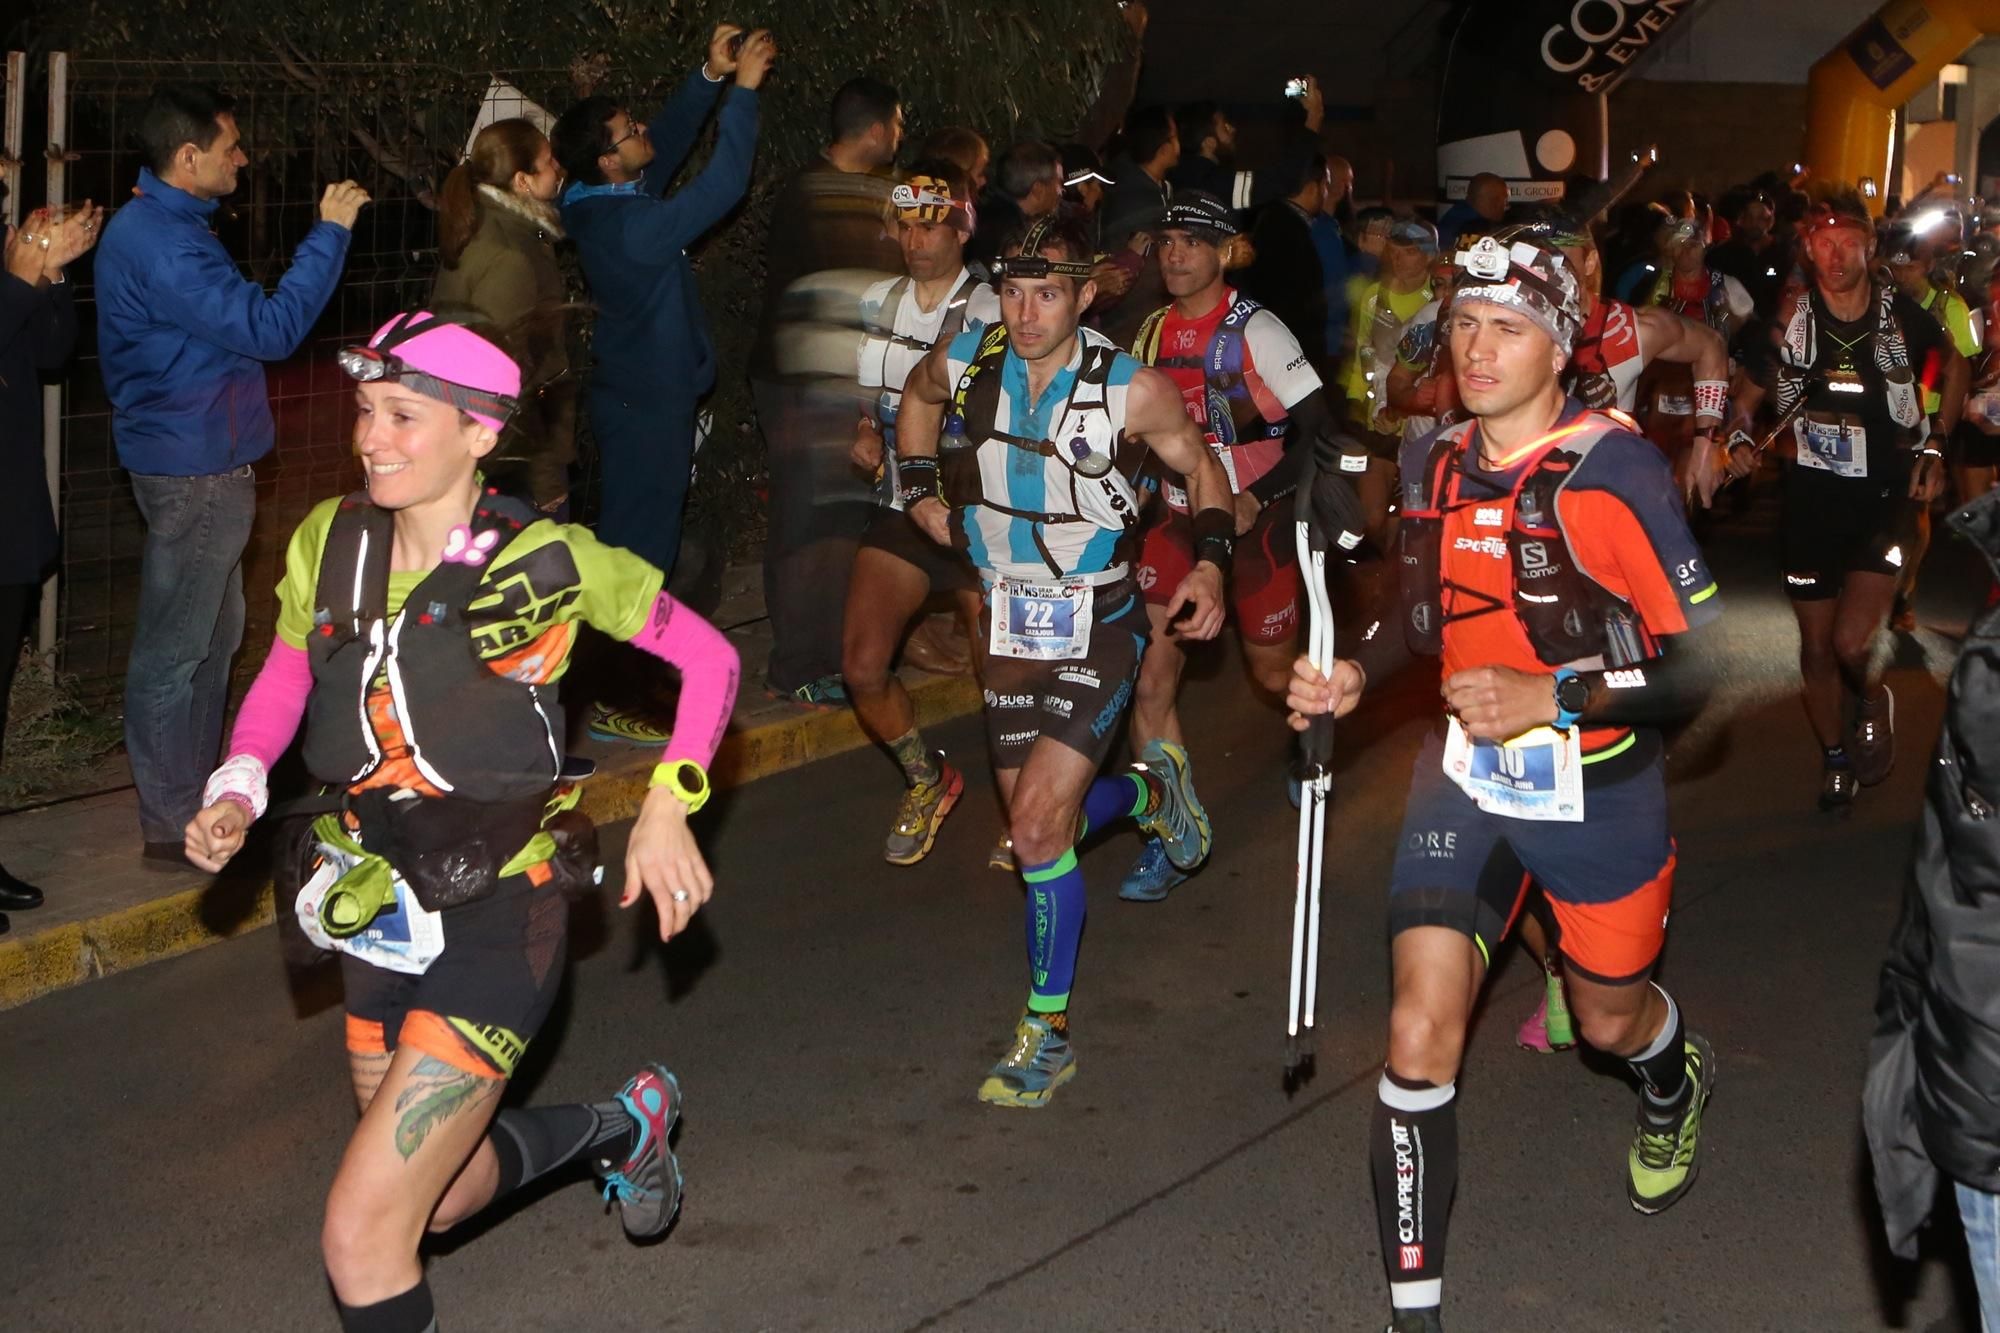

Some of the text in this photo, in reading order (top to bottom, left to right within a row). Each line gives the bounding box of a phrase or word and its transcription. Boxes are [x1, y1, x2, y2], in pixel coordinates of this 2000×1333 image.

[1819, 437, 1837, 456] 21
[1024, 600, 1055, 628] 22
[1494, 746, 1525, 778] 10
